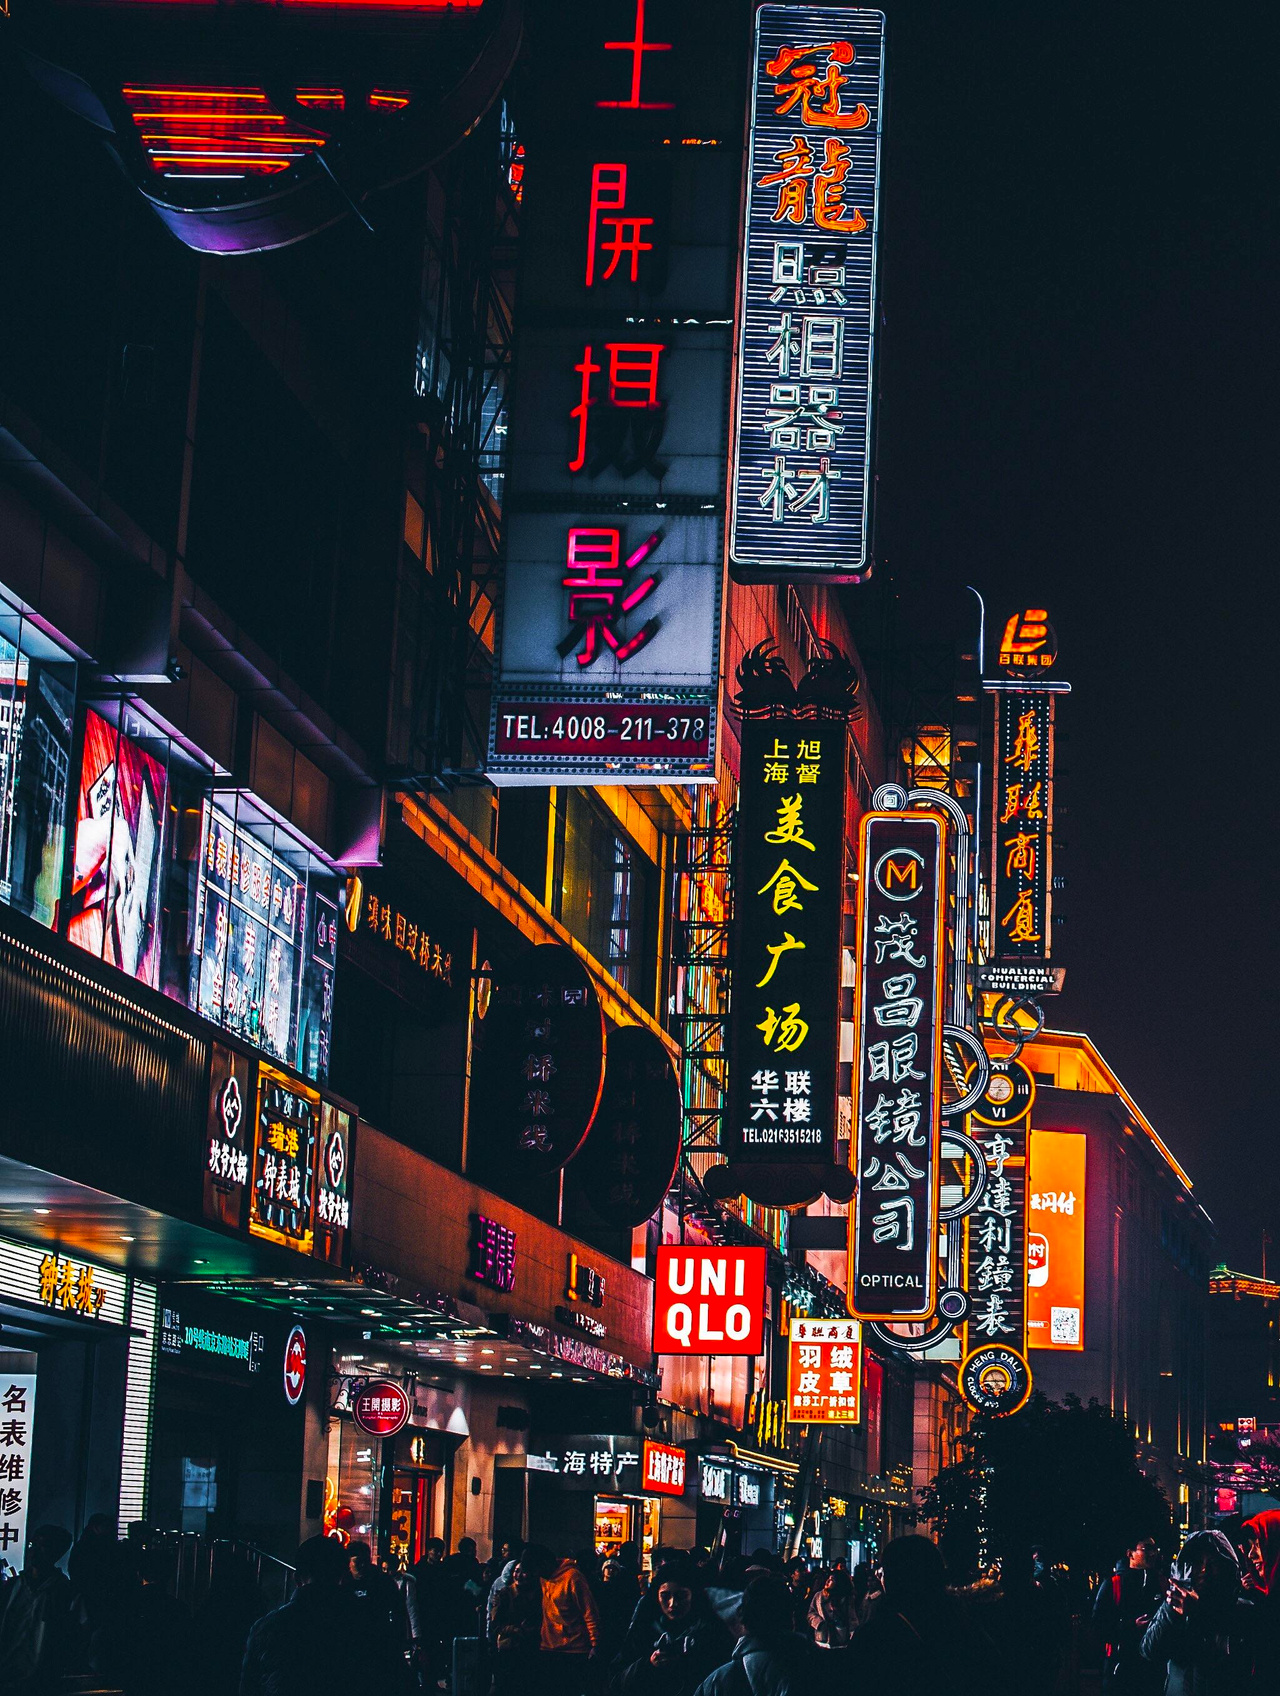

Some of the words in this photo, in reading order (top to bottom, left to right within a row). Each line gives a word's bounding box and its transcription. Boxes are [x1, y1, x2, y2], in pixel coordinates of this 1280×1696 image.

[756, 792, 820, 1053] 美食广场
[980, 974, 1055, 983] COMMERCIAL
[993, 967, 1045, 975] HUALIAN
[992, 982, 1044, 991] BUILDING
[751, 1070, 811, 1095] 华联
[863, 911, 927, 1251] 茂昌眼镜公司
[750, 1098, 811, 1122] 六楼
[992, 1107, 1006, 1118] VI
[667, 1257, 746, 1297] UNI
[861, 1274, 923, 1288] OPTICAL
[666, 1302, 752, 1347] QLO
[798, 1345, 854, 1369] 羽绒
[969, 1351, 995, 1373] HENG
[1000, 1352, 1022, 1373] DALI
[967, 1376, 984, 1403] CLOCKS
[542, 1450, 639, 1475] 上海特产
